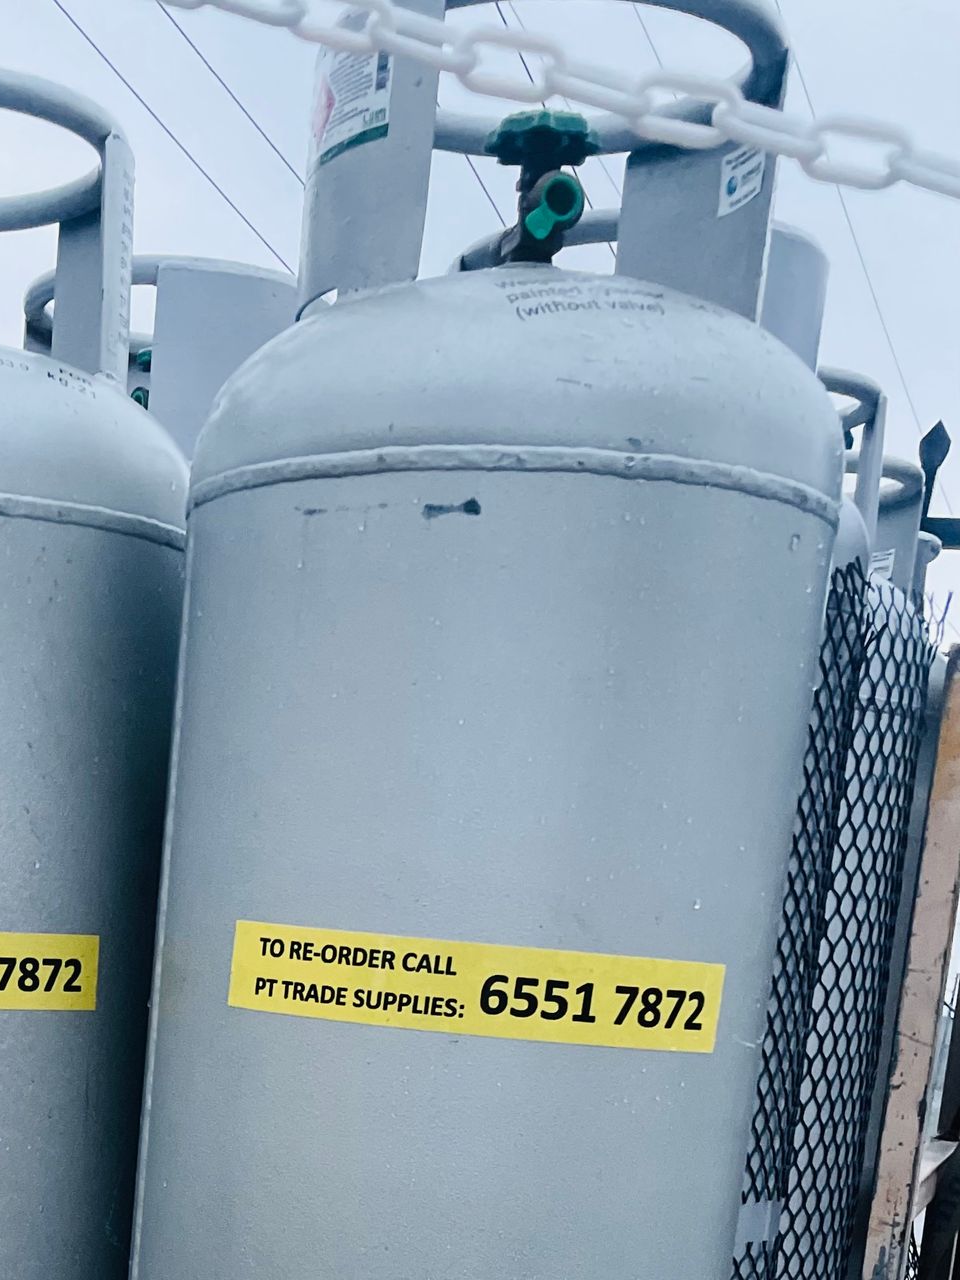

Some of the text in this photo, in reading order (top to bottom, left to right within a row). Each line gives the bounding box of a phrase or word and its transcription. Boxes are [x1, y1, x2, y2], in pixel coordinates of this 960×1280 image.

[516, 299, 601, 321] (without
[259, 937, 458, 977] TO RE-ORDER CALL
[254, 974, 705, 1031] PT TRADE SUPPLIES: 6551 7872
